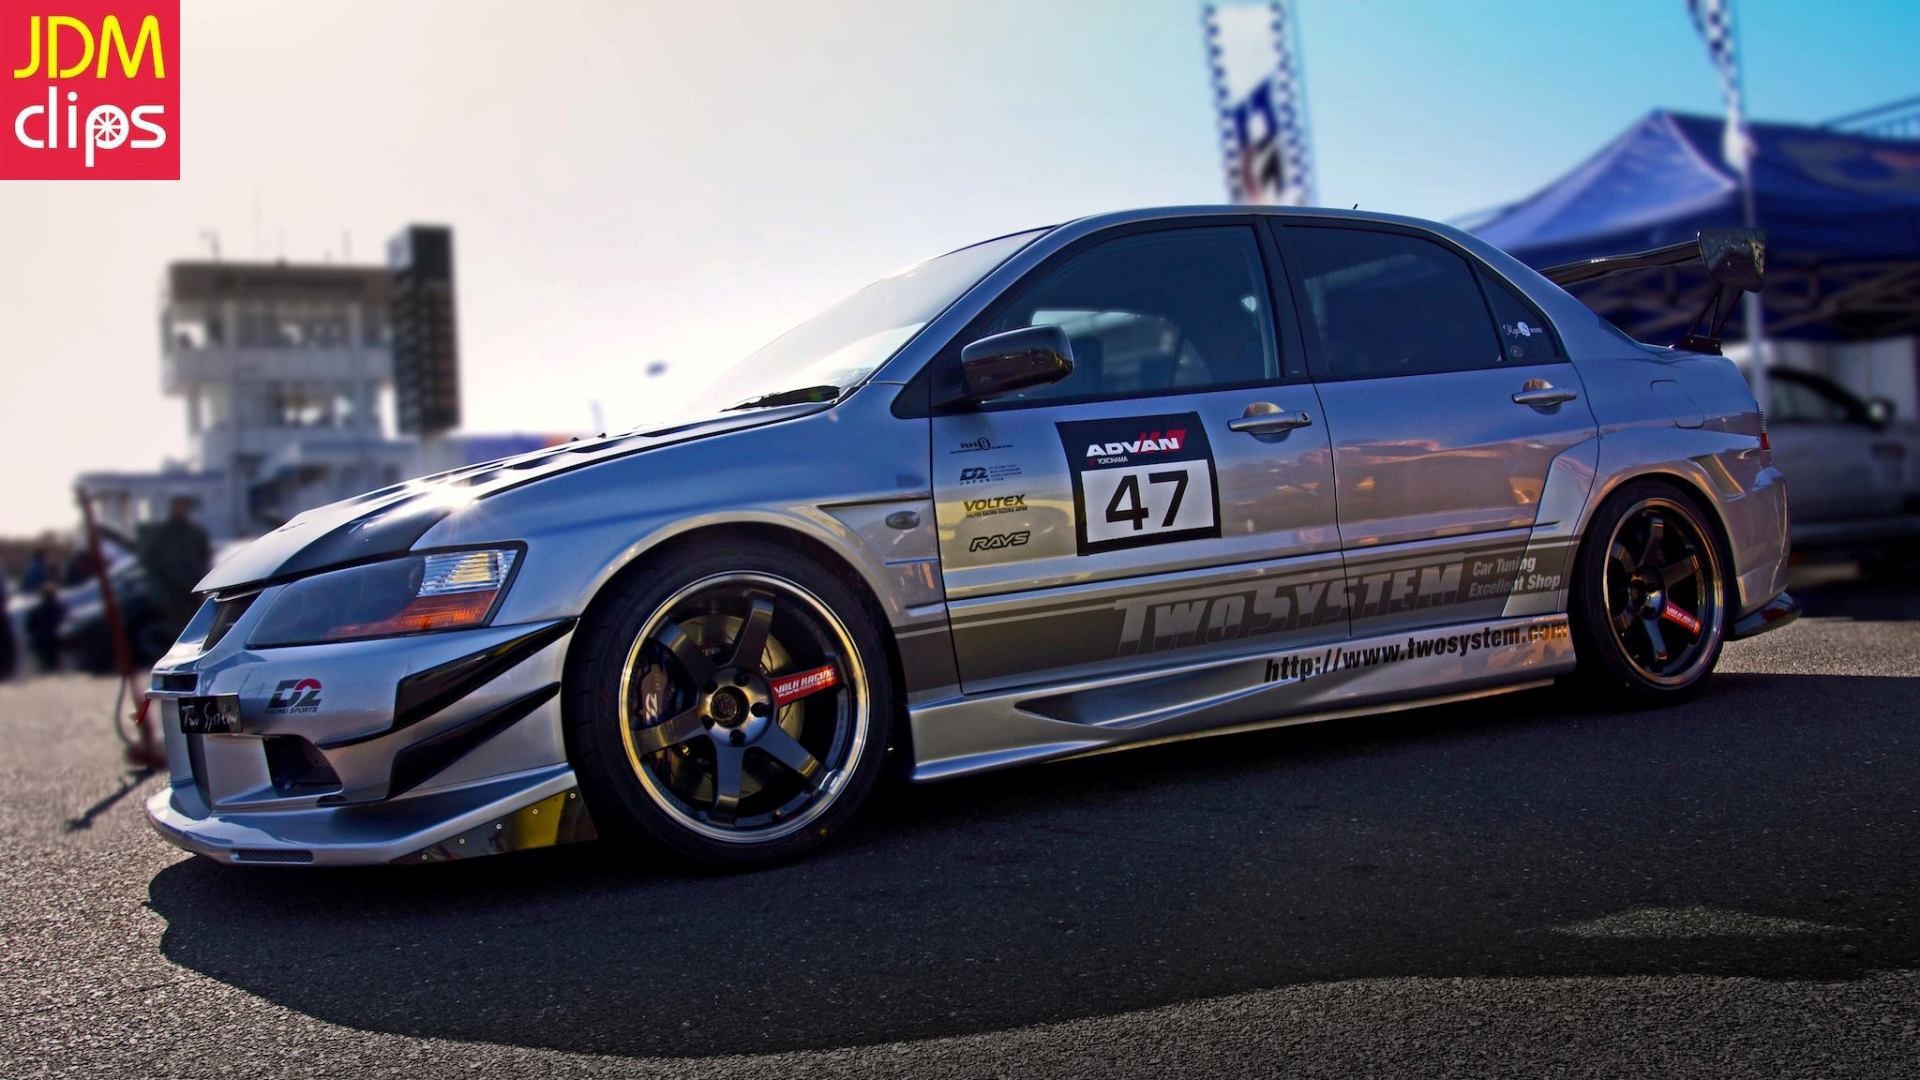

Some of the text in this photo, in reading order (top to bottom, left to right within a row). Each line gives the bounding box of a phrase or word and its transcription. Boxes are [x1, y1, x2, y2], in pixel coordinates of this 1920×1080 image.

[1086, 437, 1180, 458] ADVAN
[1097, 455, 1129, 465] YOKOHAMA
[963, 493, 1026, 512] VOLTEX
[1104, 469, 1189, 531] 47
[968, 530, 1031, 553] RAYS
[1472, 556, 1537, 577] Car Tuning
[1469, 574, 1561, 598] Excellent Shop
[1263, 622, 1569, 683] http://www.twosystem.com
[267, 678, 323, 709] D2
[289, 706, 319, 714] SPORTS
